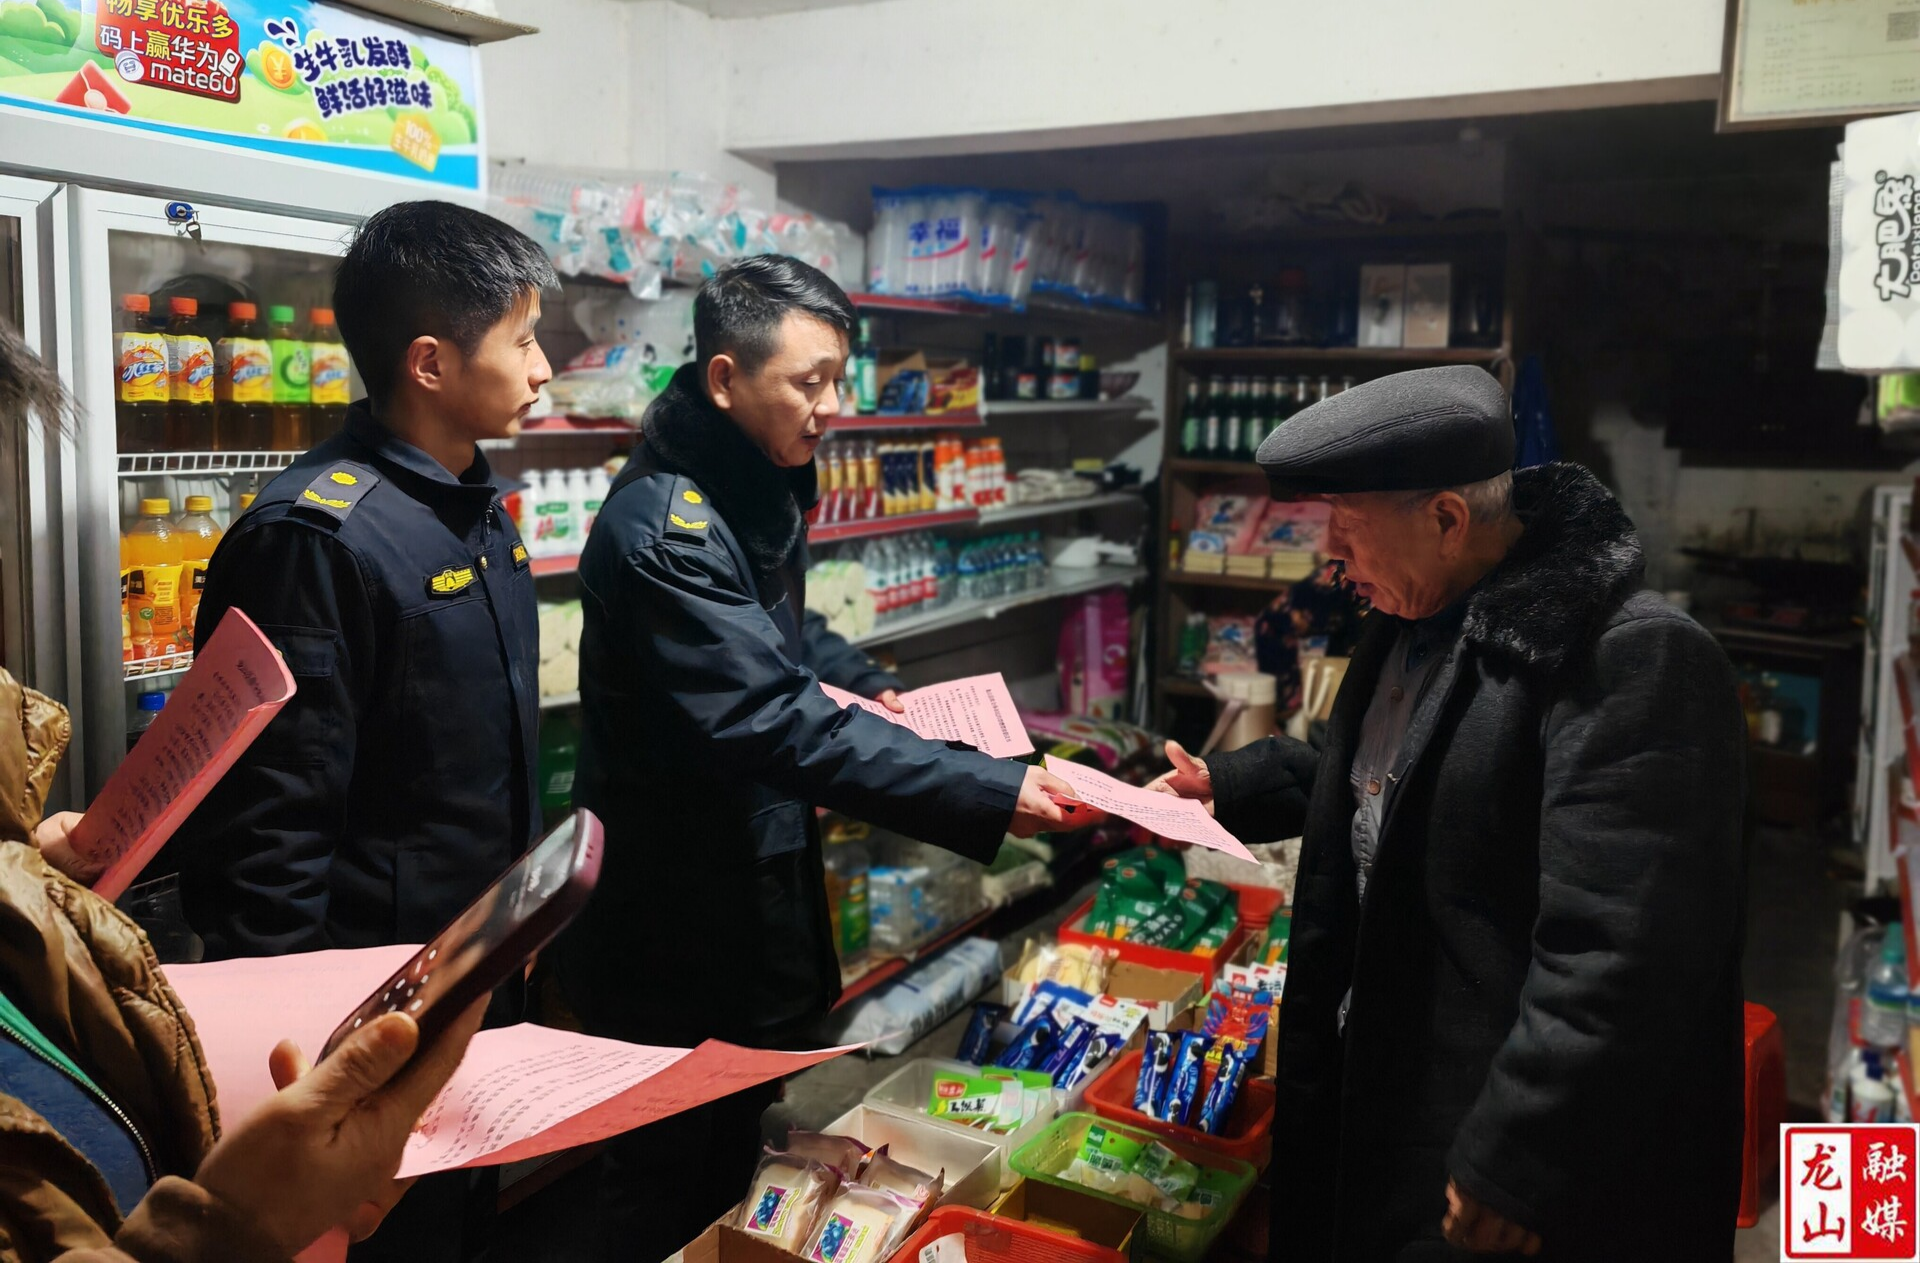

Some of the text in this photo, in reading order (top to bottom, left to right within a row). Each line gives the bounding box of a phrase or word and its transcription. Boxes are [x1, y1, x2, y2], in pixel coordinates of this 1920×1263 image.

[105, 0, 233, 38] 畅享优乐多
[100, 25, 219, 71] 码上赢华为
[294, 36, 411, 82] 生牛乳发酵
[314, 76, 433, 118] 鲜活好滋味
